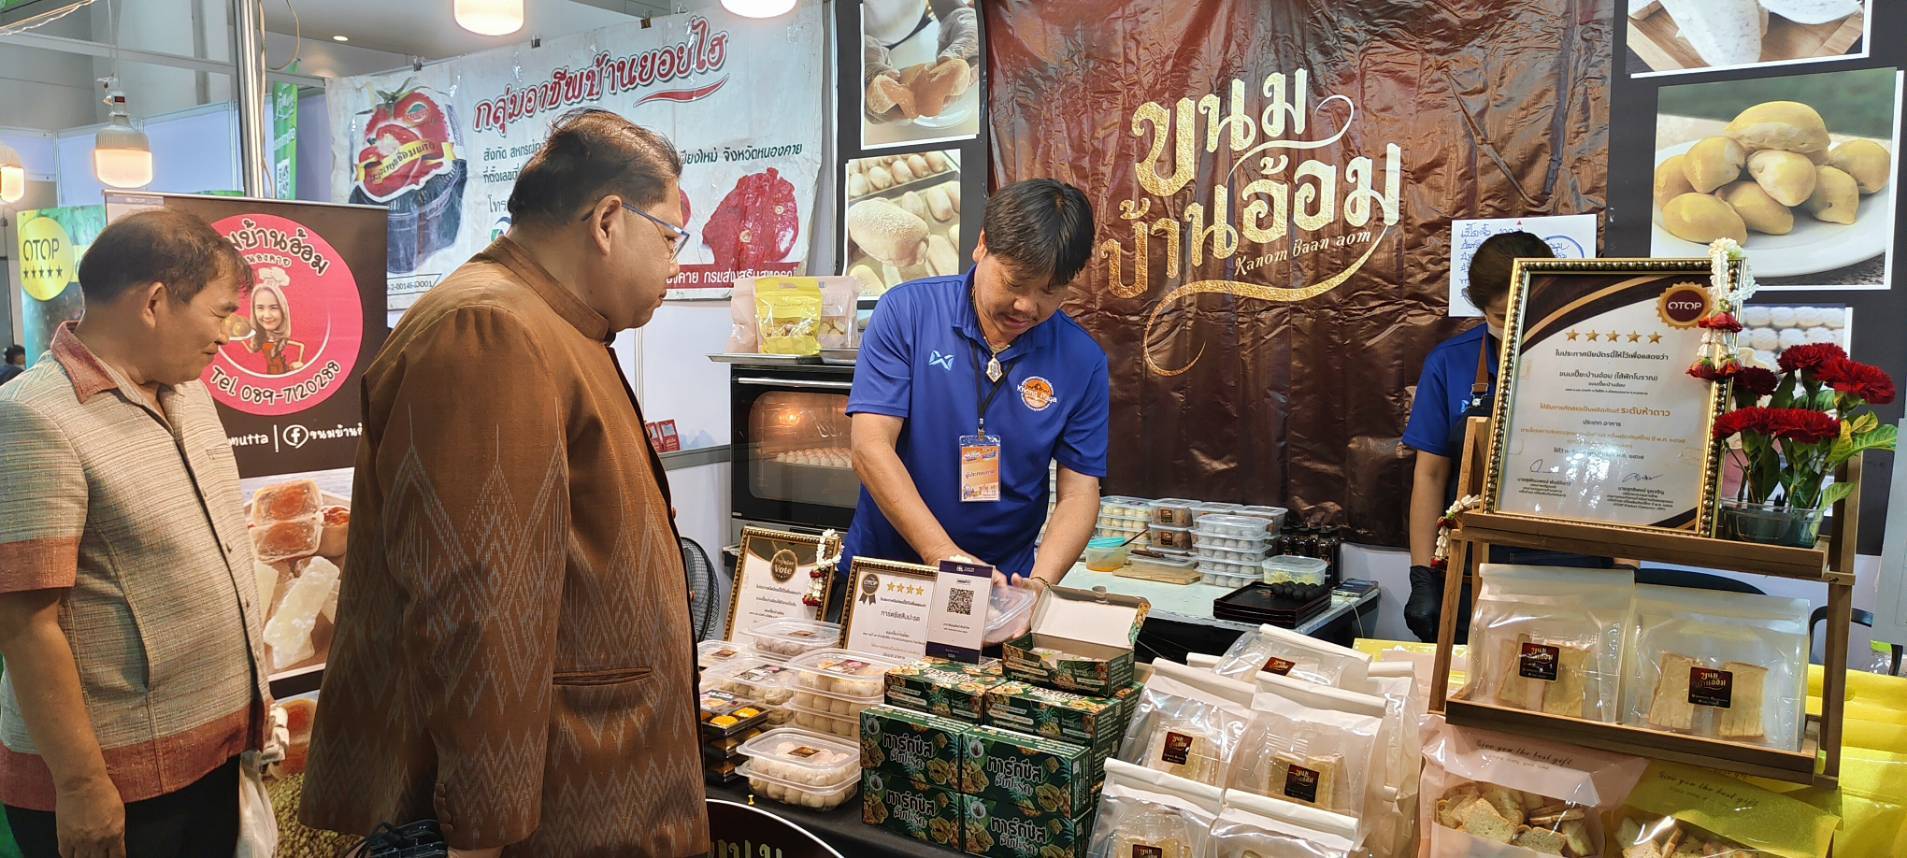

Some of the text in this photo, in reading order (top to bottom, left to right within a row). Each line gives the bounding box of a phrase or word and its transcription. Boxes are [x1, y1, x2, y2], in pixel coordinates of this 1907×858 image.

[1131, 68, 1307, 197] ขนม
[483, 146, 507, 161] สังกัด
[723, 143, 803, 162] จังหวัดหนองคาย
[1101, 143, 1400, 298] บ้านอ้อม
[23, 238, 60, 260] OTOP
[1235, 230, 1372, 276] Kanom Baan aom
[1668, 301, 1702, 311] OTOP
[211, 361, 341, 404] Tel. 089-7120288
[775, 564, 793, 575] Vote
